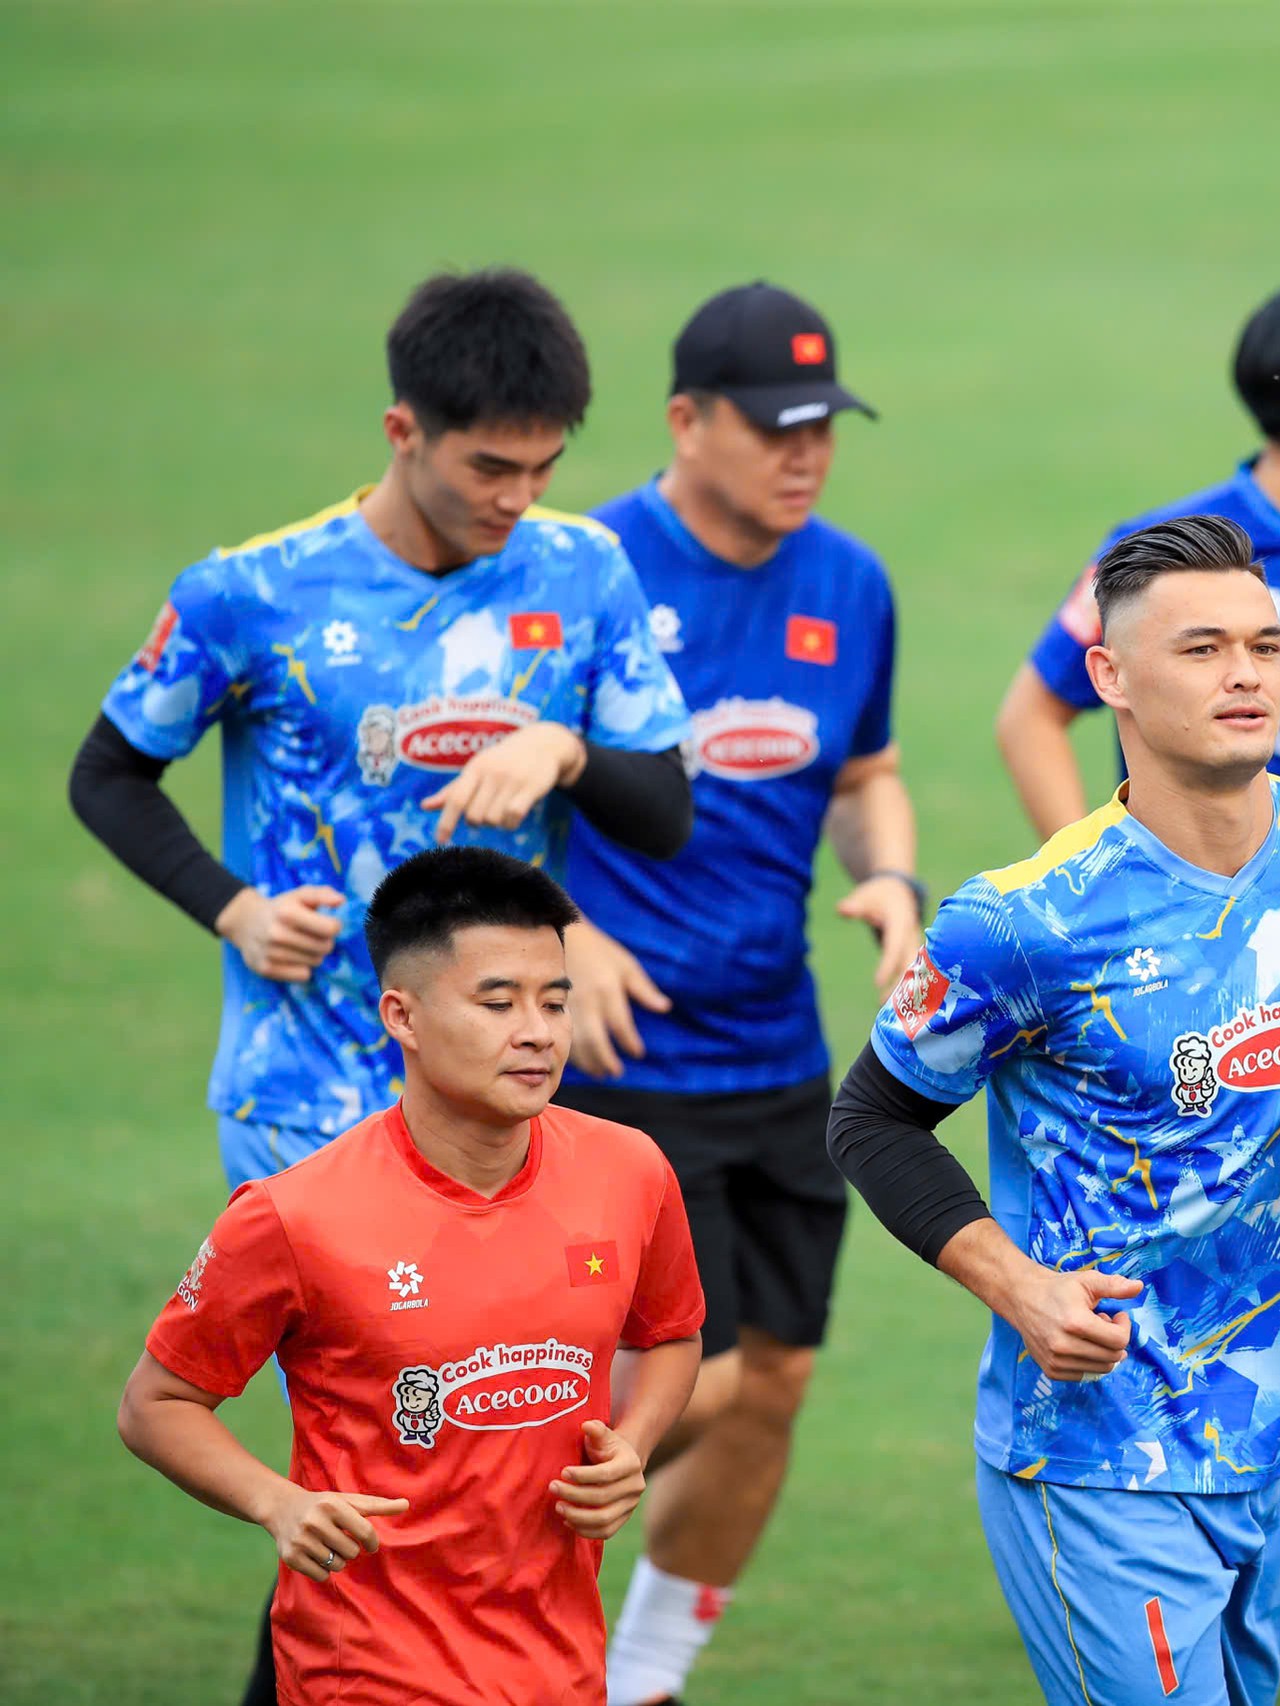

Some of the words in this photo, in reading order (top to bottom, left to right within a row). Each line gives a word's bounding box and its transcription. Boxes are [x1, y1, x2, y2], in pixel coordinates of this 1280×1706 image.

[1211, 1012, 1256, 1048] Cook
[442, 1352, 493, 1383] Cook
[498, 1343, 592, 1369] happiness
[1144, 1596, 1180, 1697] 1
